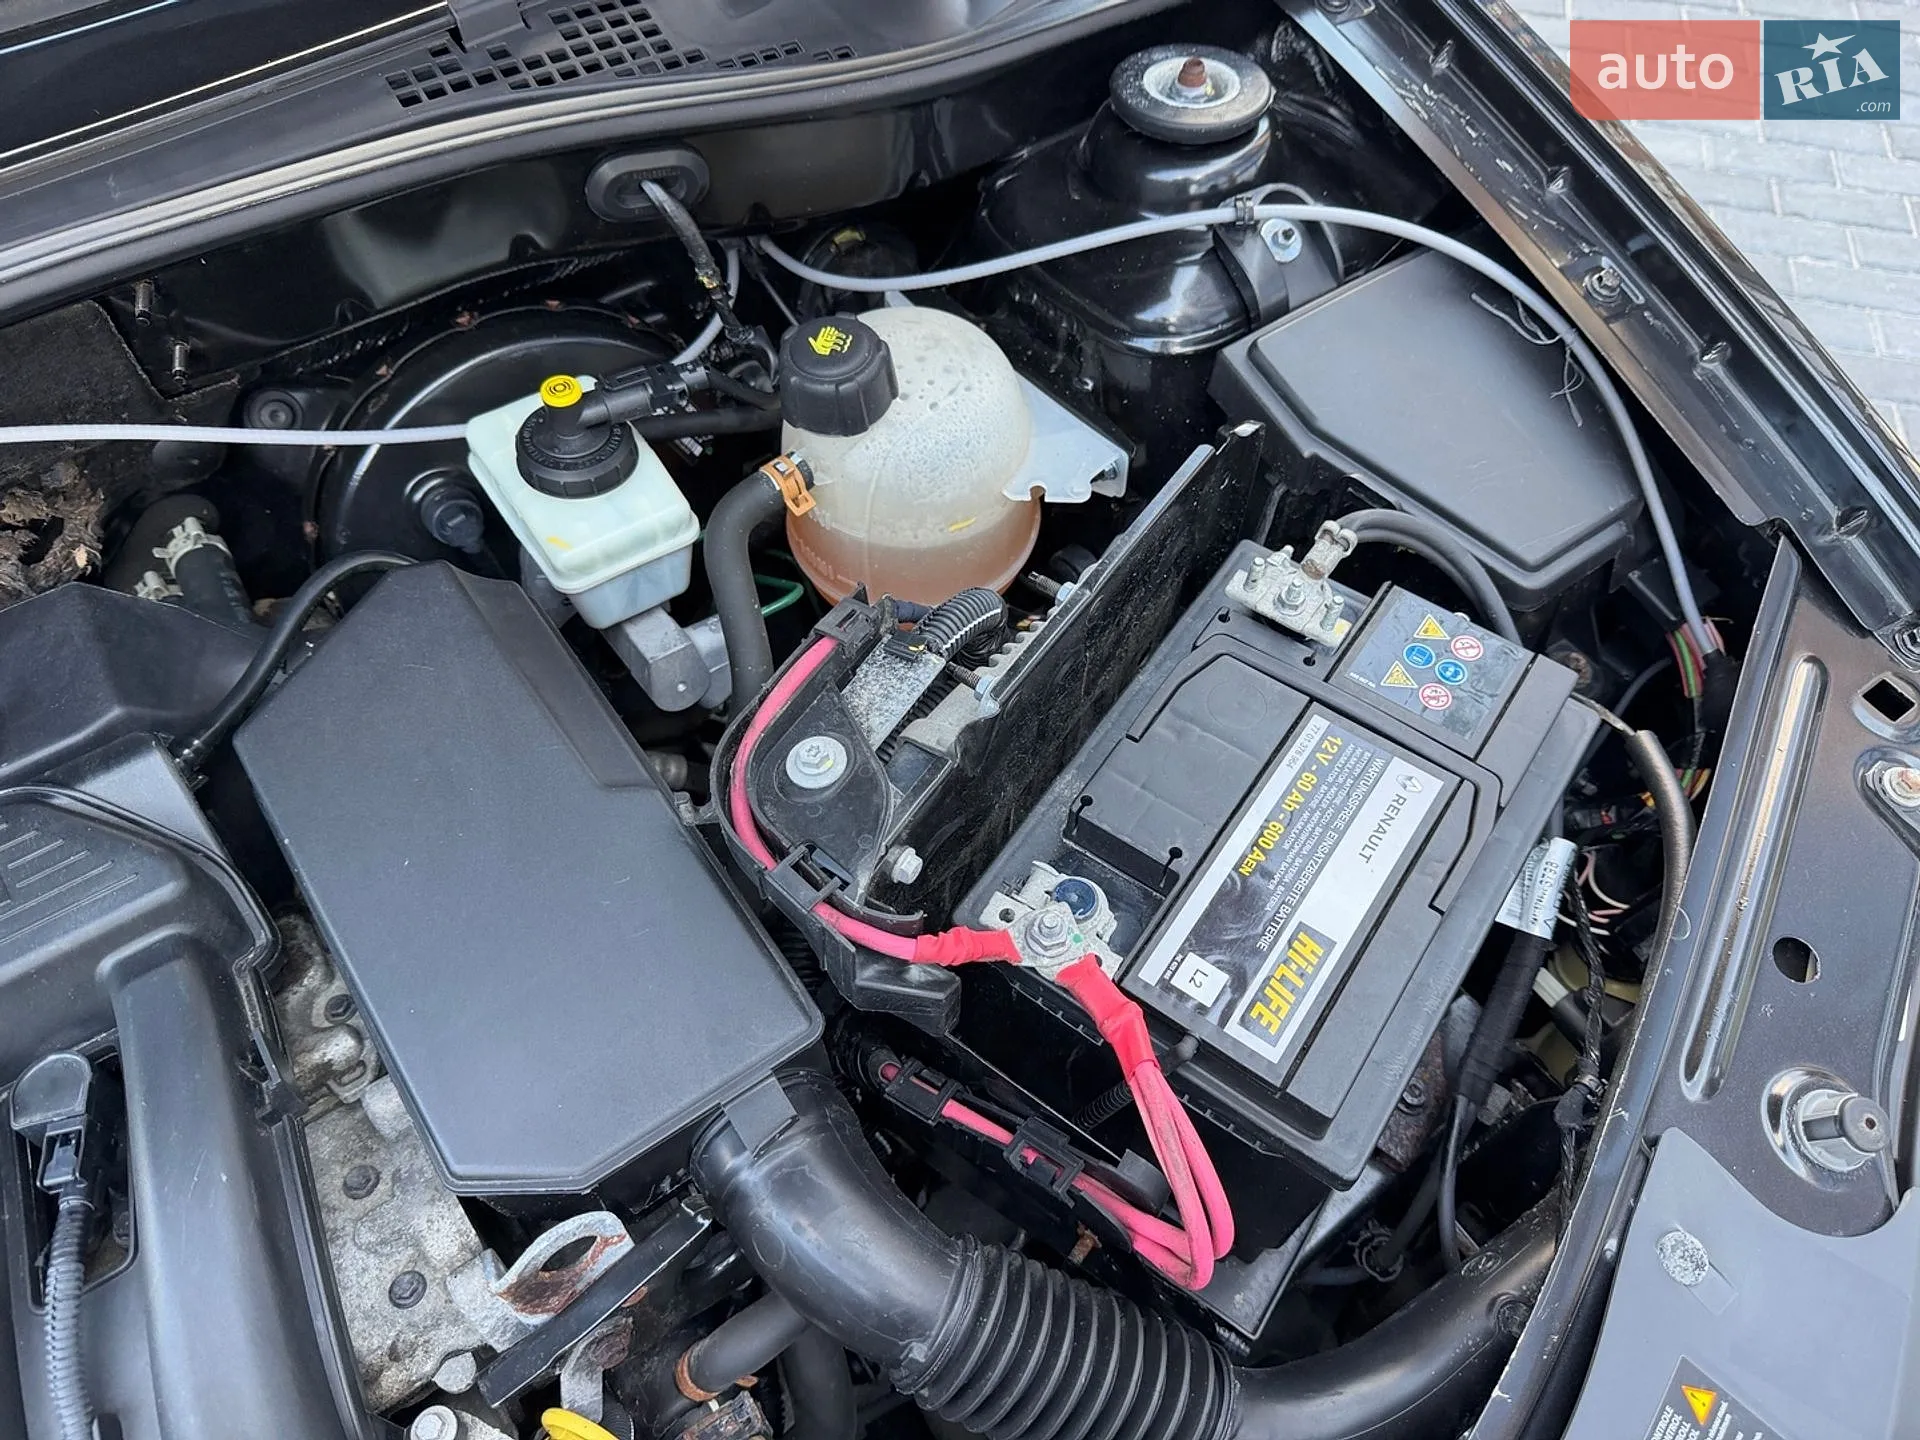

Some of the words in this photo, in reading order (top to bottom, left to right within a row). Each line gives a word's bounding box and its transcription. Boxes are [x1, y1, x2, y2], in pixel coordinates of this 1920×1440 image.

[1312, 748, 1333, 766] V
[1320, 732, 1344, 755] 12
[1294, 770, 1319, 793] 60
[1329, 755, 1385, 833] WARTUNGSFREIE,
[1280, 787, 1307, 814] Ah
[1256, 819, 1286, 851] 600
[1356, 792, 1407, 864] RENAULT
[1283, 829, 1339, 907] EINSATZBEREITE
[1254, 902, 1292, 952] BATTERIE
[1187, 967, 1208, 990] L2
[1247, 930, 1324, 1035] Hi-LIFE
